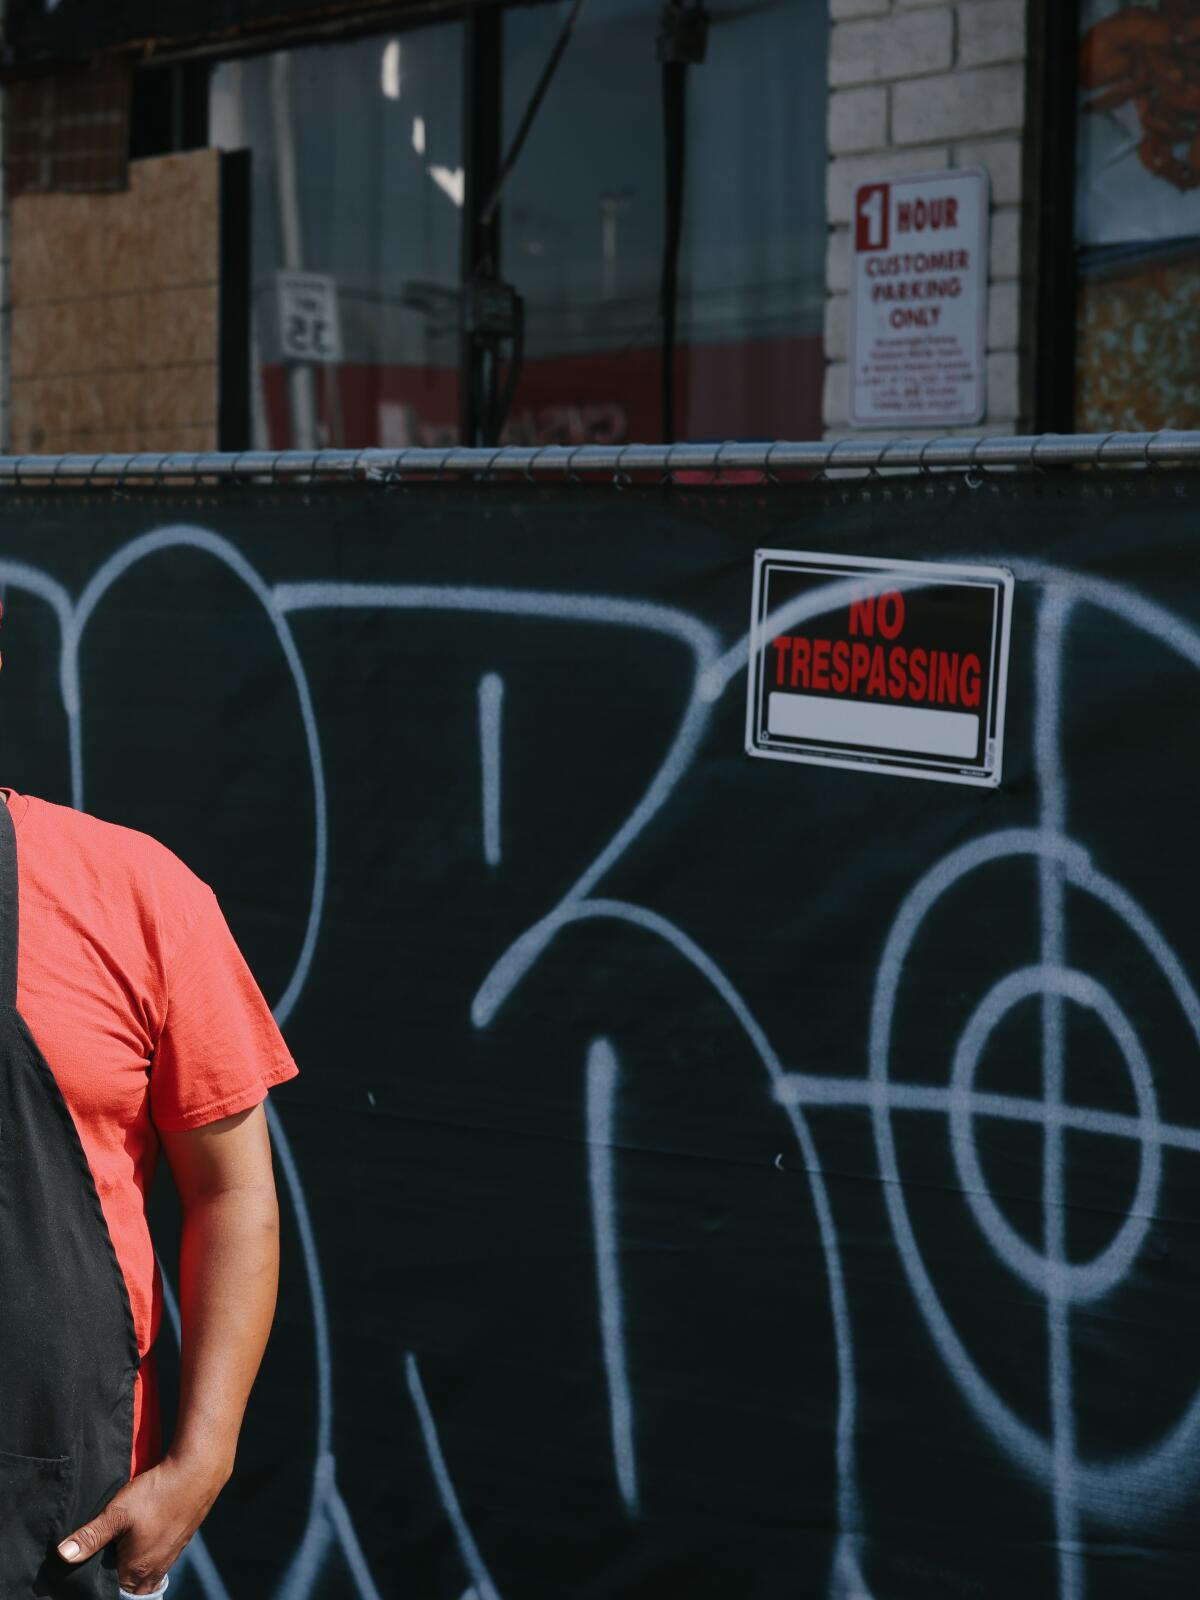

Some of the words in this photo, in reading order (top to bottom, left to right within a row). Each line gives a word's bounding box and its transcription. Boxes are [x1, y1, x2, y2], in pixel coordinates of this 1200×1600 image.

[860, 186, 885, 250] 1
[896, 197, 959, 234] HOUR
[866, 248, 971, 278] CUSTOMER
[871, 277, 962, 303] PARKING
[889, 305, 942, 330] ONLY
[848, 588, 905, 639] NO
[772, 635, 982, 707] TRESPASSING
